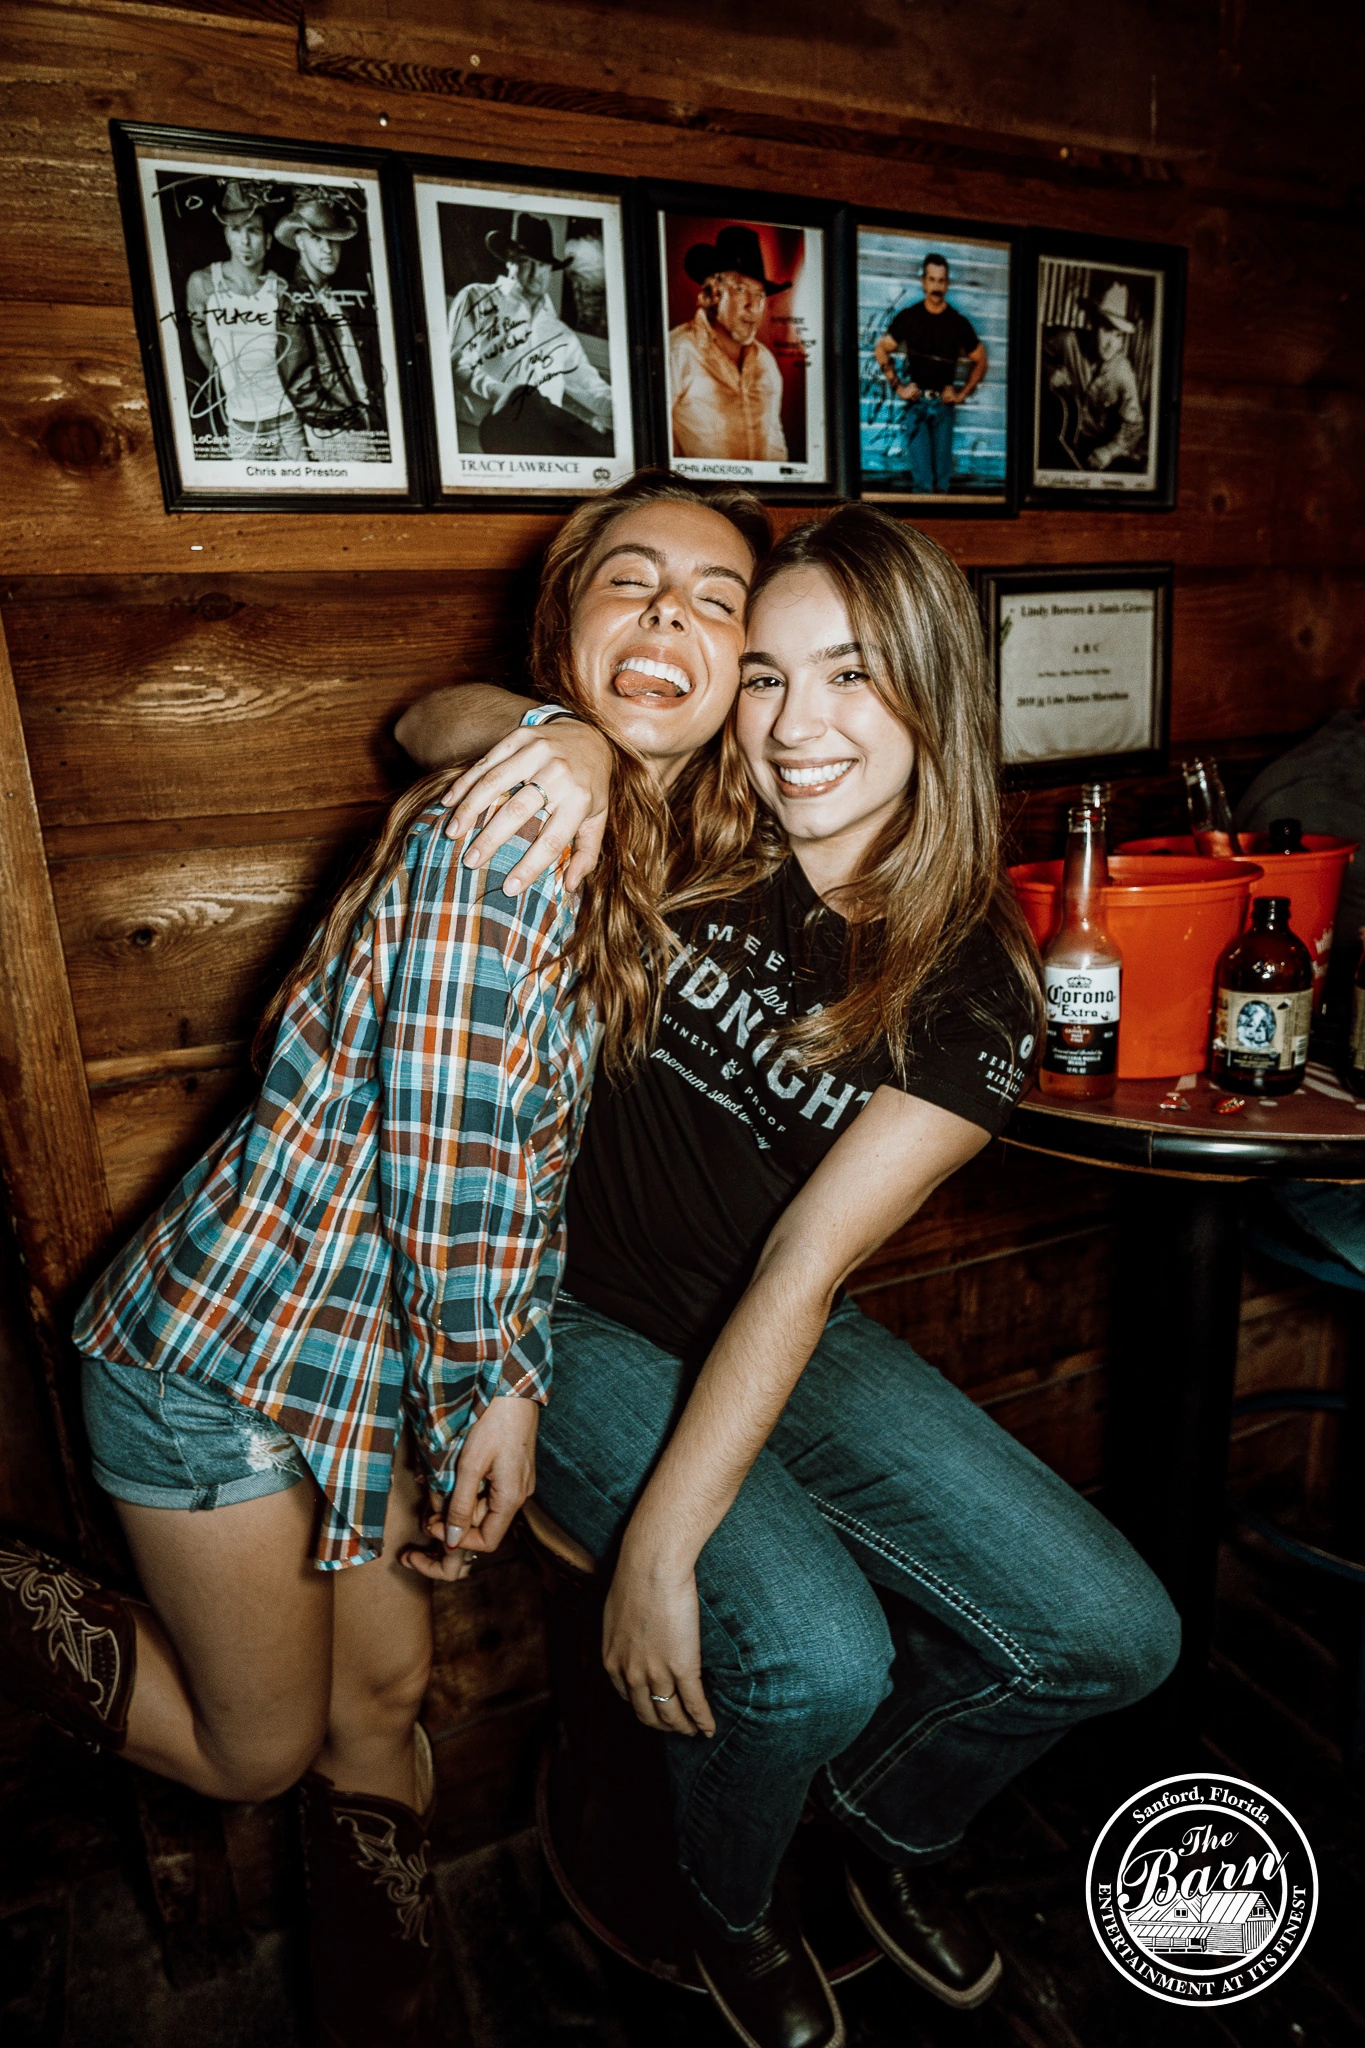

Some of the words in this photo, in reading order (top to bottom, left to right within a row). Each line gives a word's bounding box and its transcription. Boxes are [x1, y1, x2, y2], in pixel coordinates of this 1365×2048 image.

[246, 466, 276, 477] Chris
[280, 467, 300, 477] and
[305, 467, 348, 478] Preston
[460, 459, 505, 472] TRACY
[509, 460, 581, 474] LAWRENCE
[701, 464, 753, 476] ANDERSON
[1047, 984, 1115, 1008] Corona
[1061, 1004, 1098, 1017] Extra
[645, 931, 874, 1130] IDNIGH
[650, 1047, 708, 1094] premium
[706, 1089, 743, 1116] select
[662, 1013, 719, 1058] NINETY
[744, 1086, 787, 1134] PROOF
